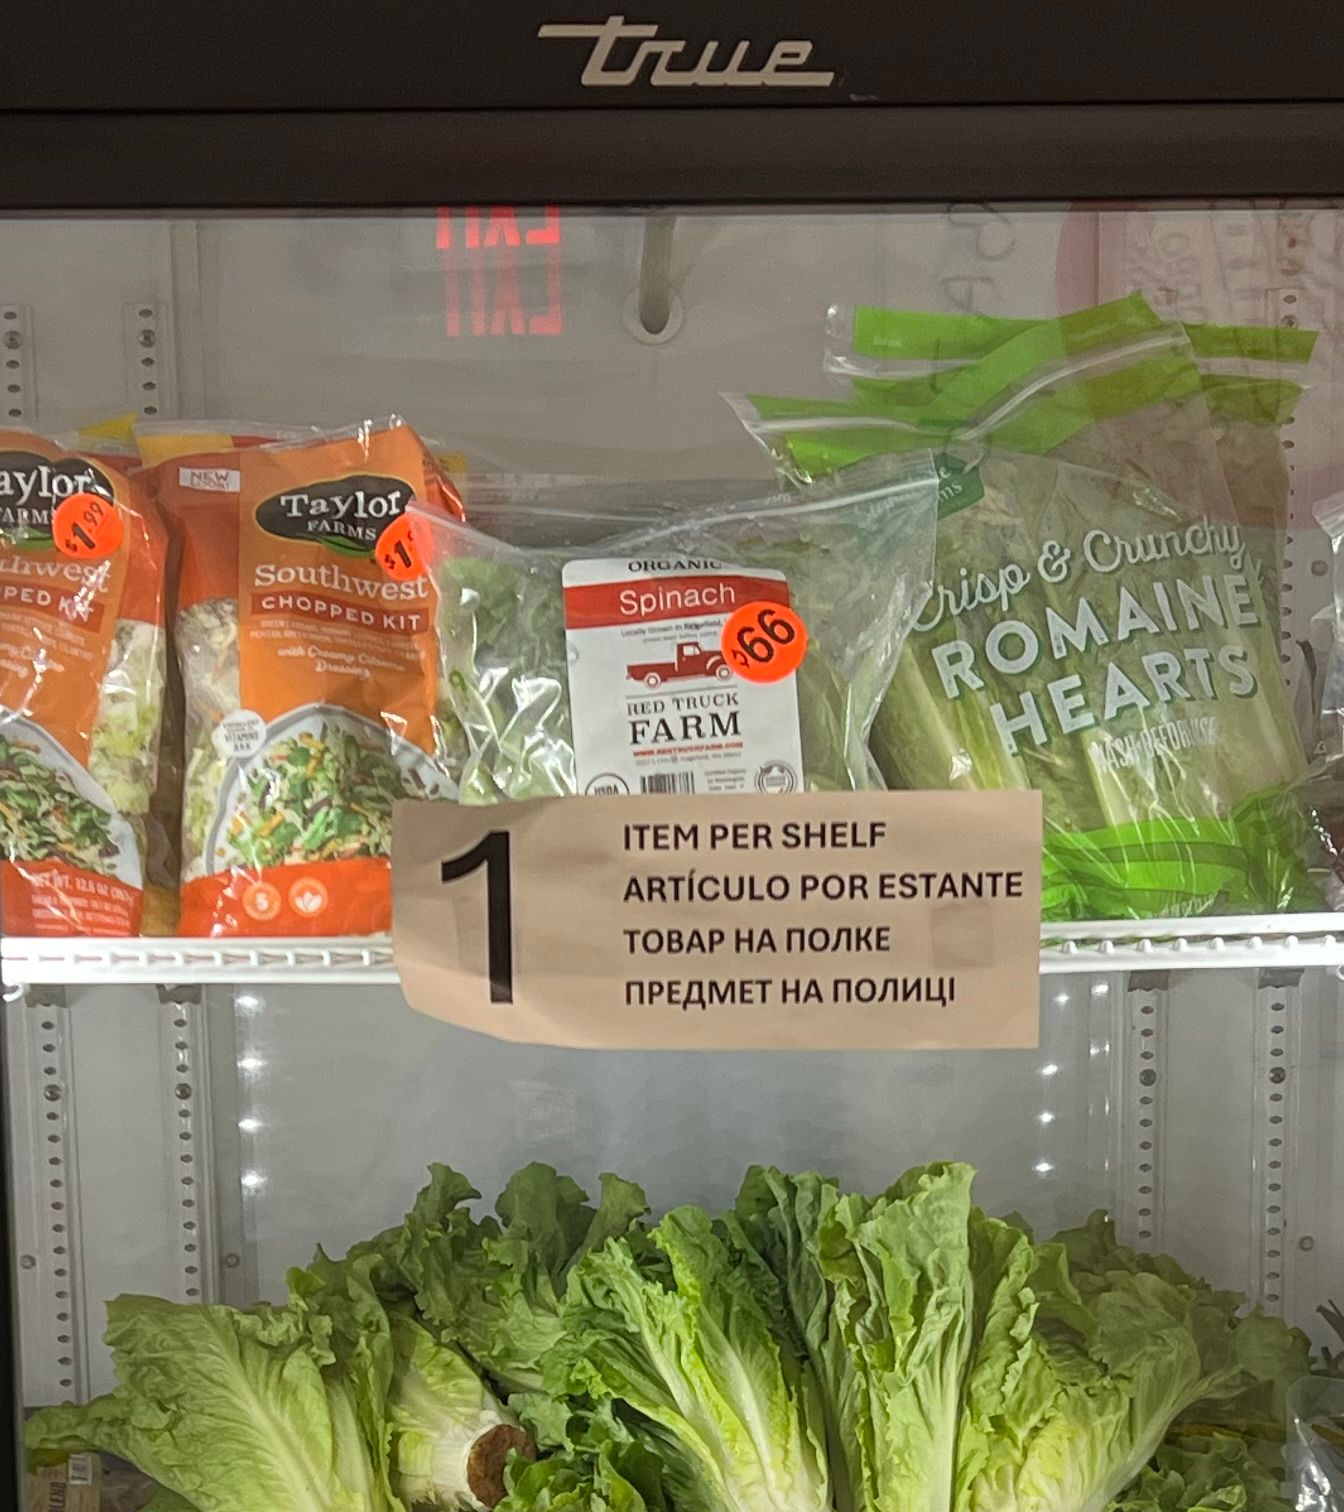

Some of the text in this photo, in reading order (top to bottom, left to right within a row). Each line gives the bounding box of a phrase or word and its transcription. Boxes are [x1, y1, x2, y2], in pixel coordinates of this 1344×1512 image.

[537, 15, 834, 86] true
[190, 471, 230, 481] NEW
[280, 491, 401, 519] Taylor
[65, 501, 104, 553] $1.99
[307, 520, 377, 540] FARMS
[1037, 540, 1070, 583] &
[1083, 523, 1245, 572] Crunchy
[255, 563, 428, 600] Southwest
[261, 595, 421, 631] CHOPPED KIT
[619, 583, 736, 617] Spinach
[931, 575, 1259, 698] ROMAINE
[627, 692, 739, 716] RED TRUCK
[990, 644, 1255, 756] HEARTS
[629, 710, 742, 746] FARM
[624, 821, 887, 851] ITEM PER SHELF
[624, 869, 1024, 903] ARTÍCULO POR ESTANTE
[441, 830, 513, 1005] 1
[624, 927, 891, 955] ТОВАР НА ПОЛКЕ
[625, 977, 956, 1012] ПРЕДМЕТ НА ПОЛИЦІ
